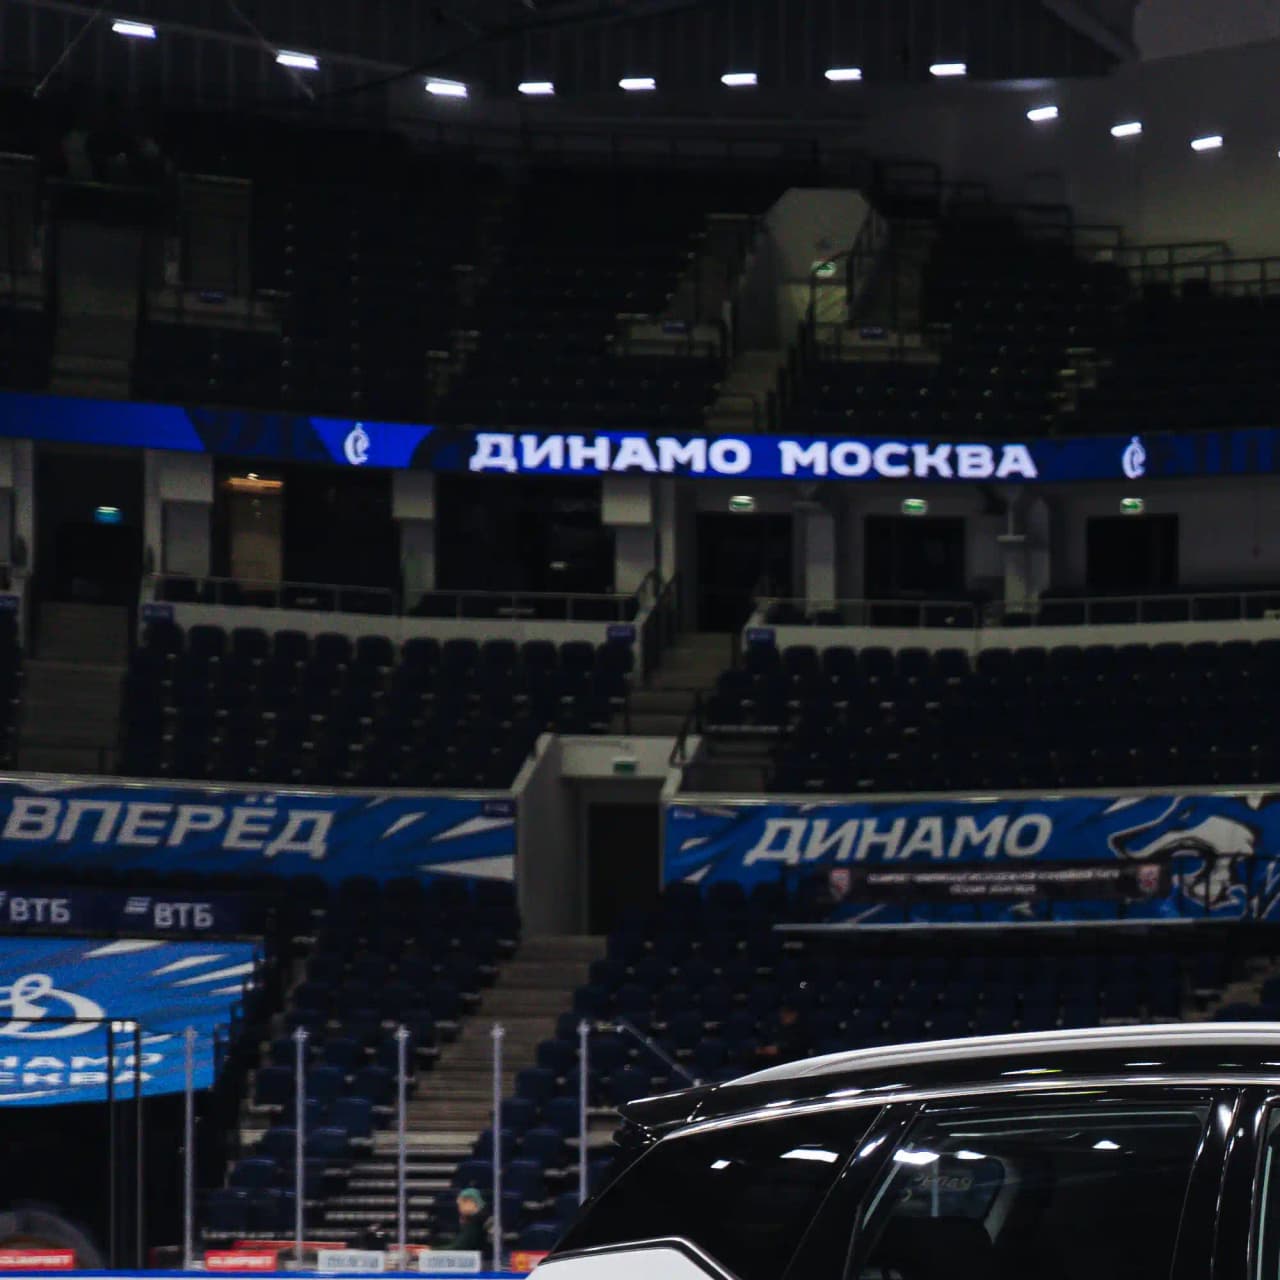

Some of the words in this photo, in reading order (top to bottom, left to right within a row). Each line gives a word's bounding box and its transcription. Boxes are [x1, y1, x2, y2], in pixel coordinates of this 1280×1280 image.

[469, 432, 752, 474] ДИНАМО
[779, 440, 1039, 479] МОСКВА
[3, 793, 334, 861] ВПЕРЁД
[743, 813, 1052, 866] ДИНАМО
[10, 897, 71, 924] ВТБ
[153, 902, 214, 928] ВТБ
